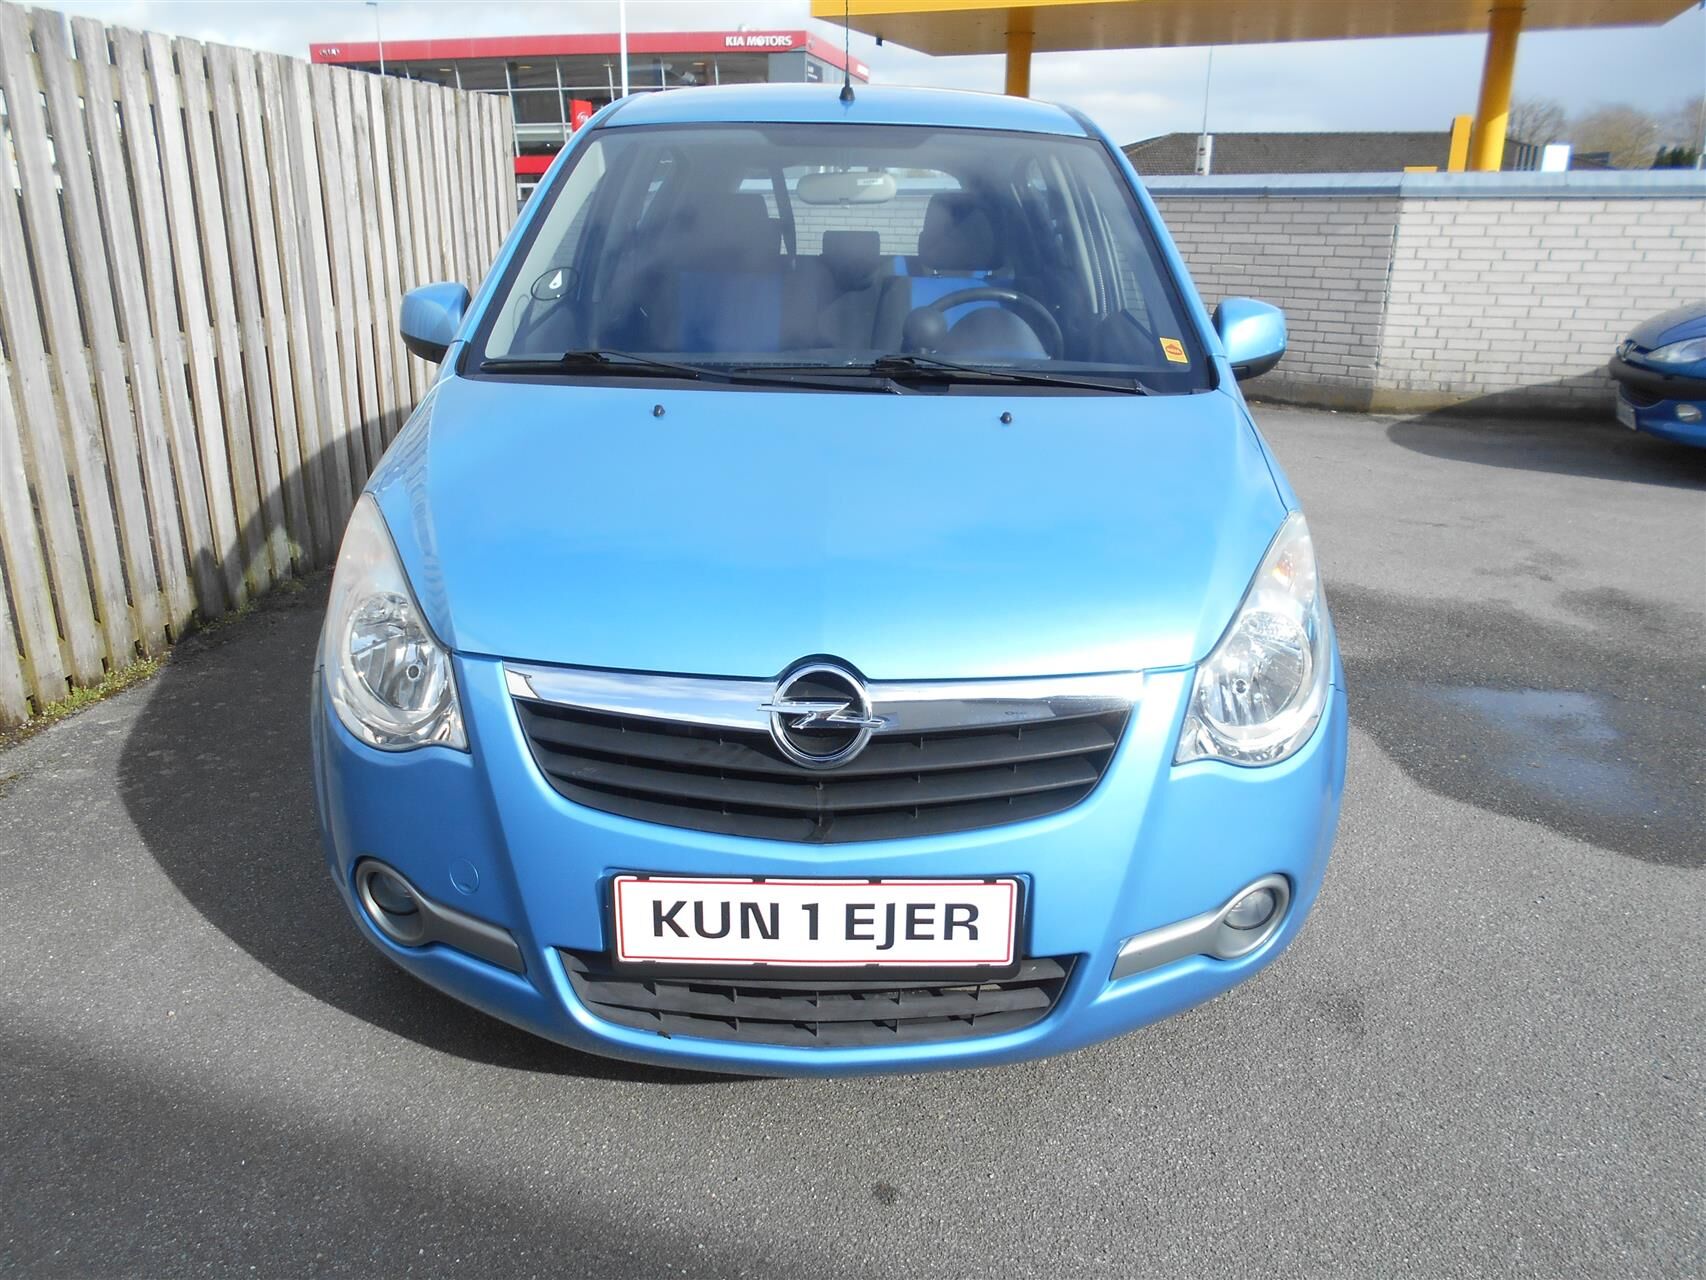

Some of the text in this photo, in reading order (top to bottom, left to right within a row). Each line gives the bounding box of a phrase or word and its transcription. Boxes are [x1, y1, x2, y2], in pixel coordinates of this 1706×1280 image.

[725, 35, 793, 46] KIA MOTORS
[652, 900, 979, 950] KUN 1 EJER
